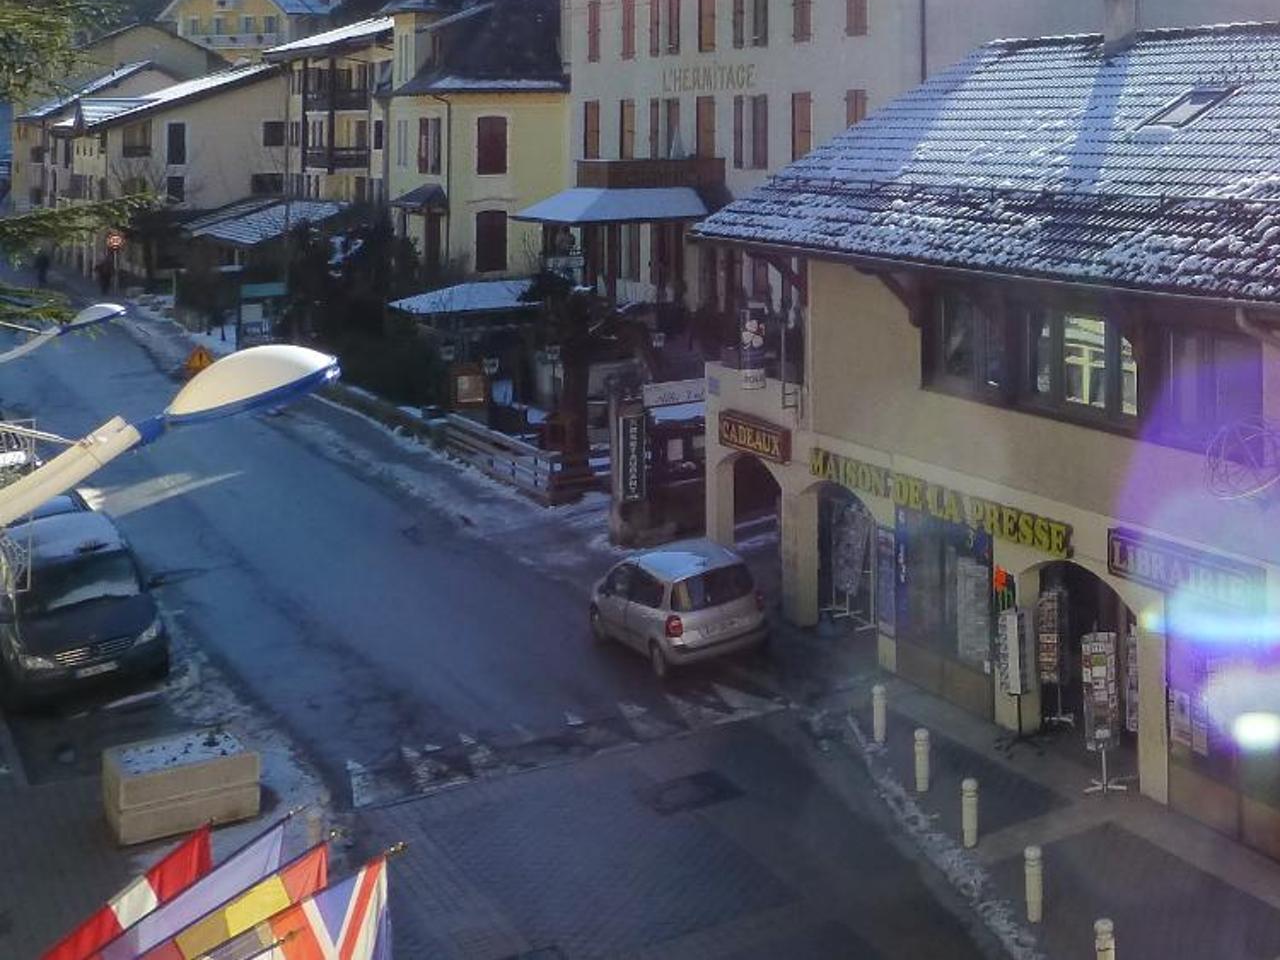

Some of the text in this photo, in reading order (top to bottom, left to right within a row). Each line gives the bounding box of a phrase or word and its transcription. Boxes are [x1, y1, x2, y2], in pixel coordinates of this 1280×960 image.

[722, 421, 781, 457] CADEAUX
[809, 448, 888, 498] MAISON
[892, 474, 923, 509] DE
[926, 485, 963, 523] LA
[968, 498, 1071, 557] PRESSE
